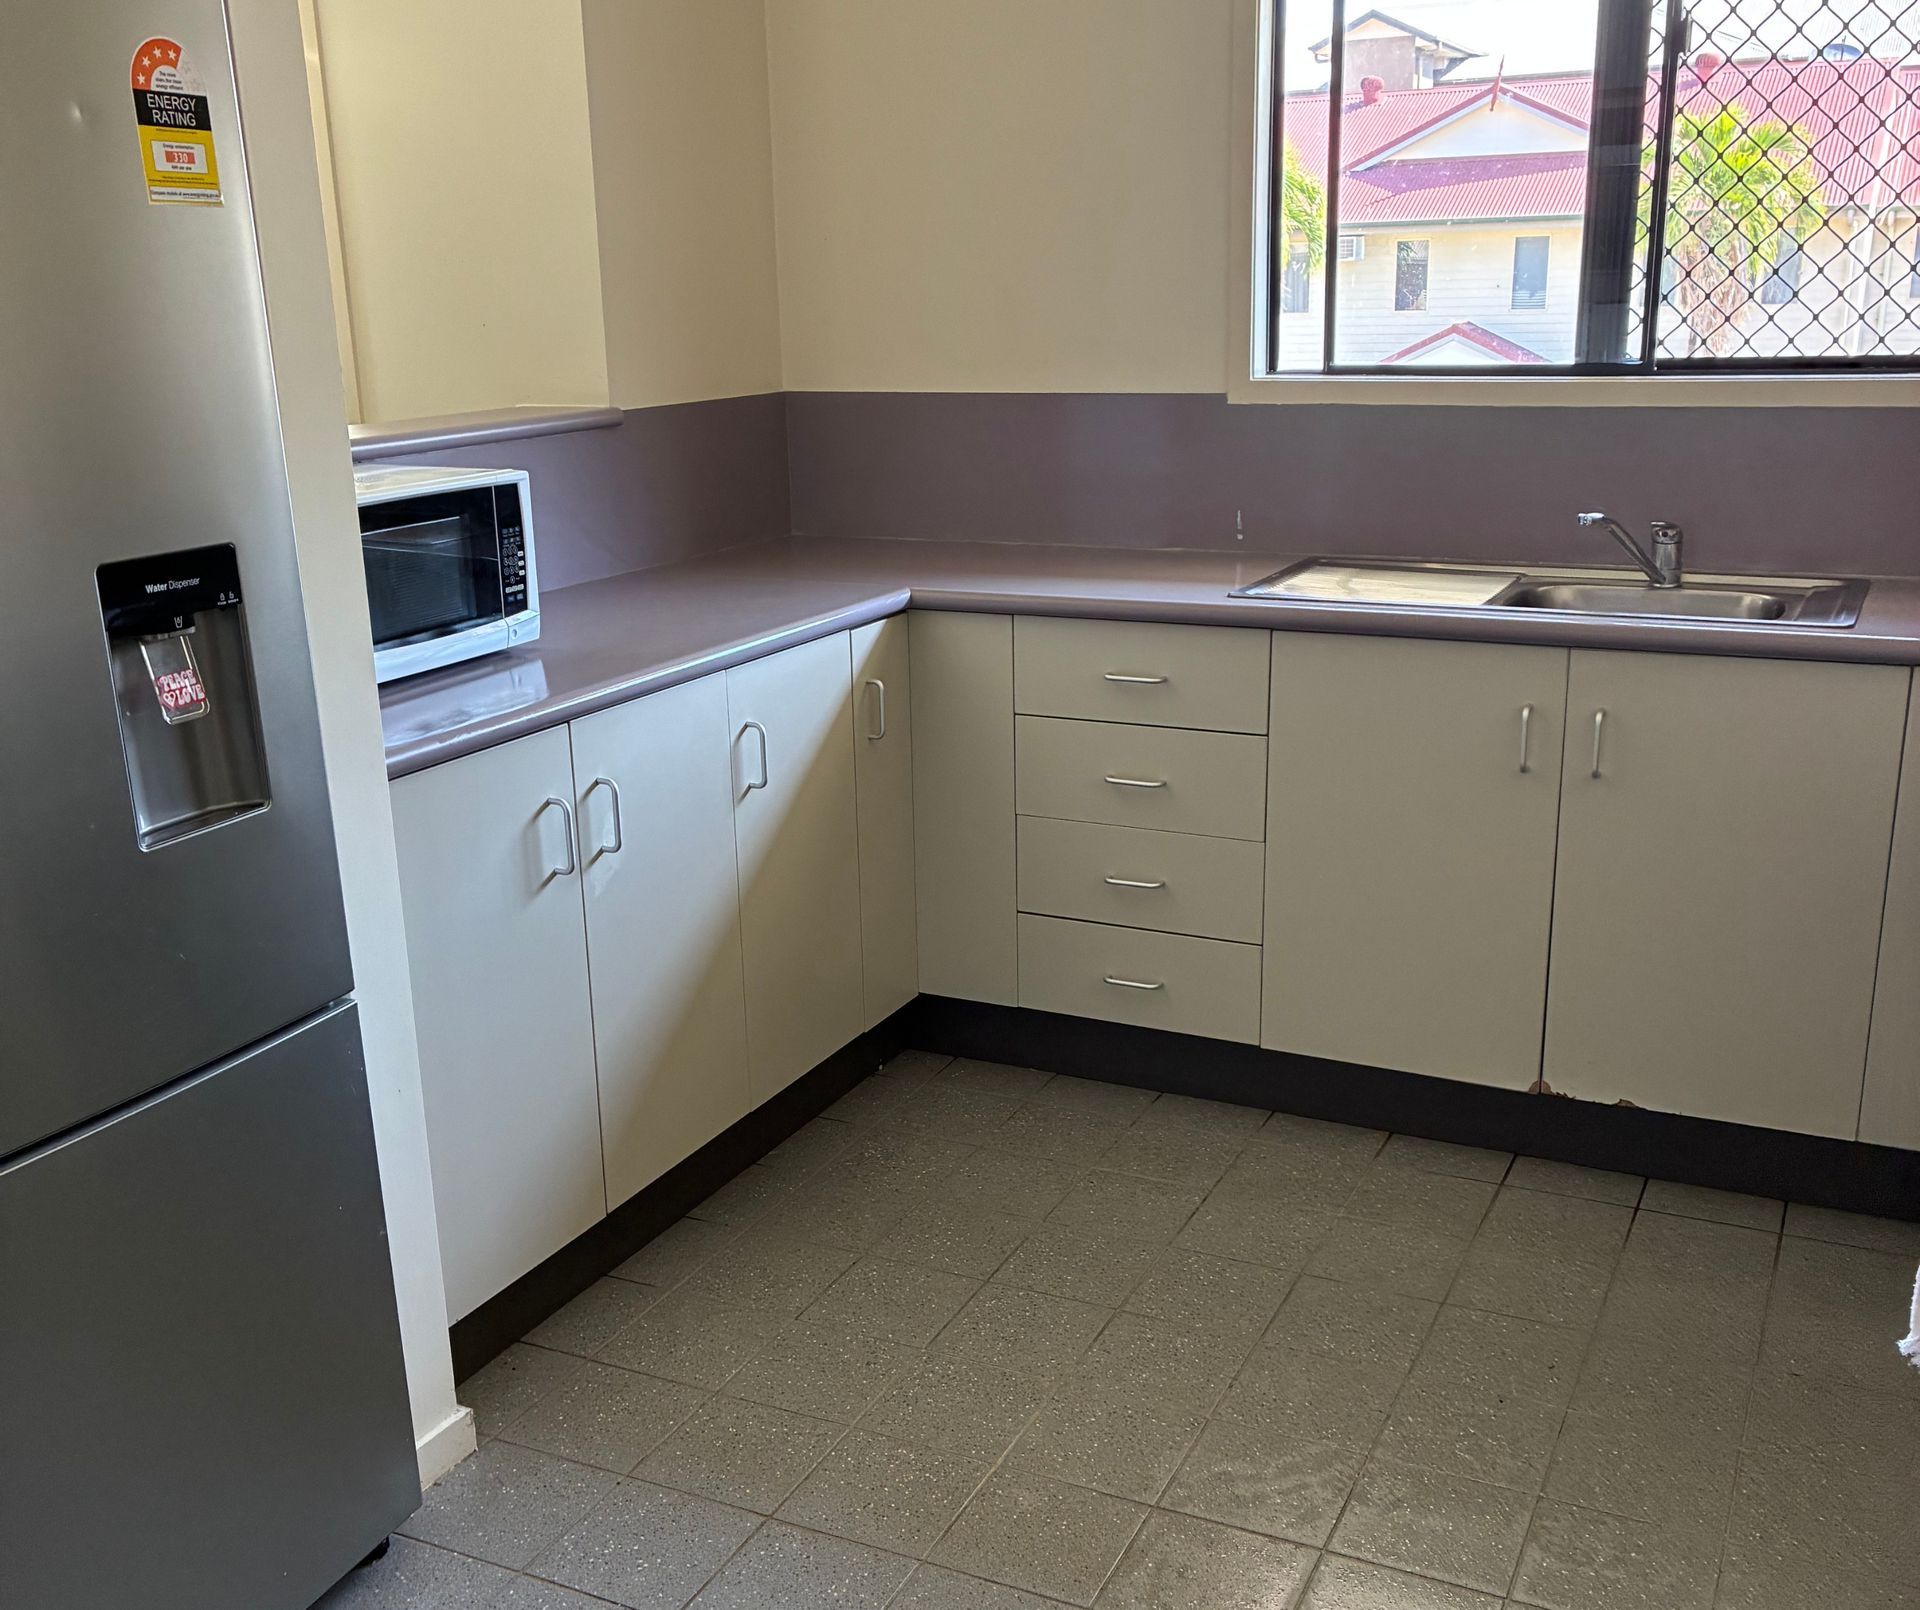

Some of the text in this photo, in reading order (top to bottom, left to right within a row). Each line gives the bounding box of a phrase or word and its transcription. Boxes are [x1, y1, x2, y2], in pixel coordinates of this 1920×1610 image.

[147, 93, 196, 112] ENERGY
[152, 109, 196, 126] RATING
[172, 152, 188, 163] 330
[145, 577, 200, 594] Water Dispenser
[157, 669, 197, 692] PEACE
[175, 684, 205, 705] LOVE
